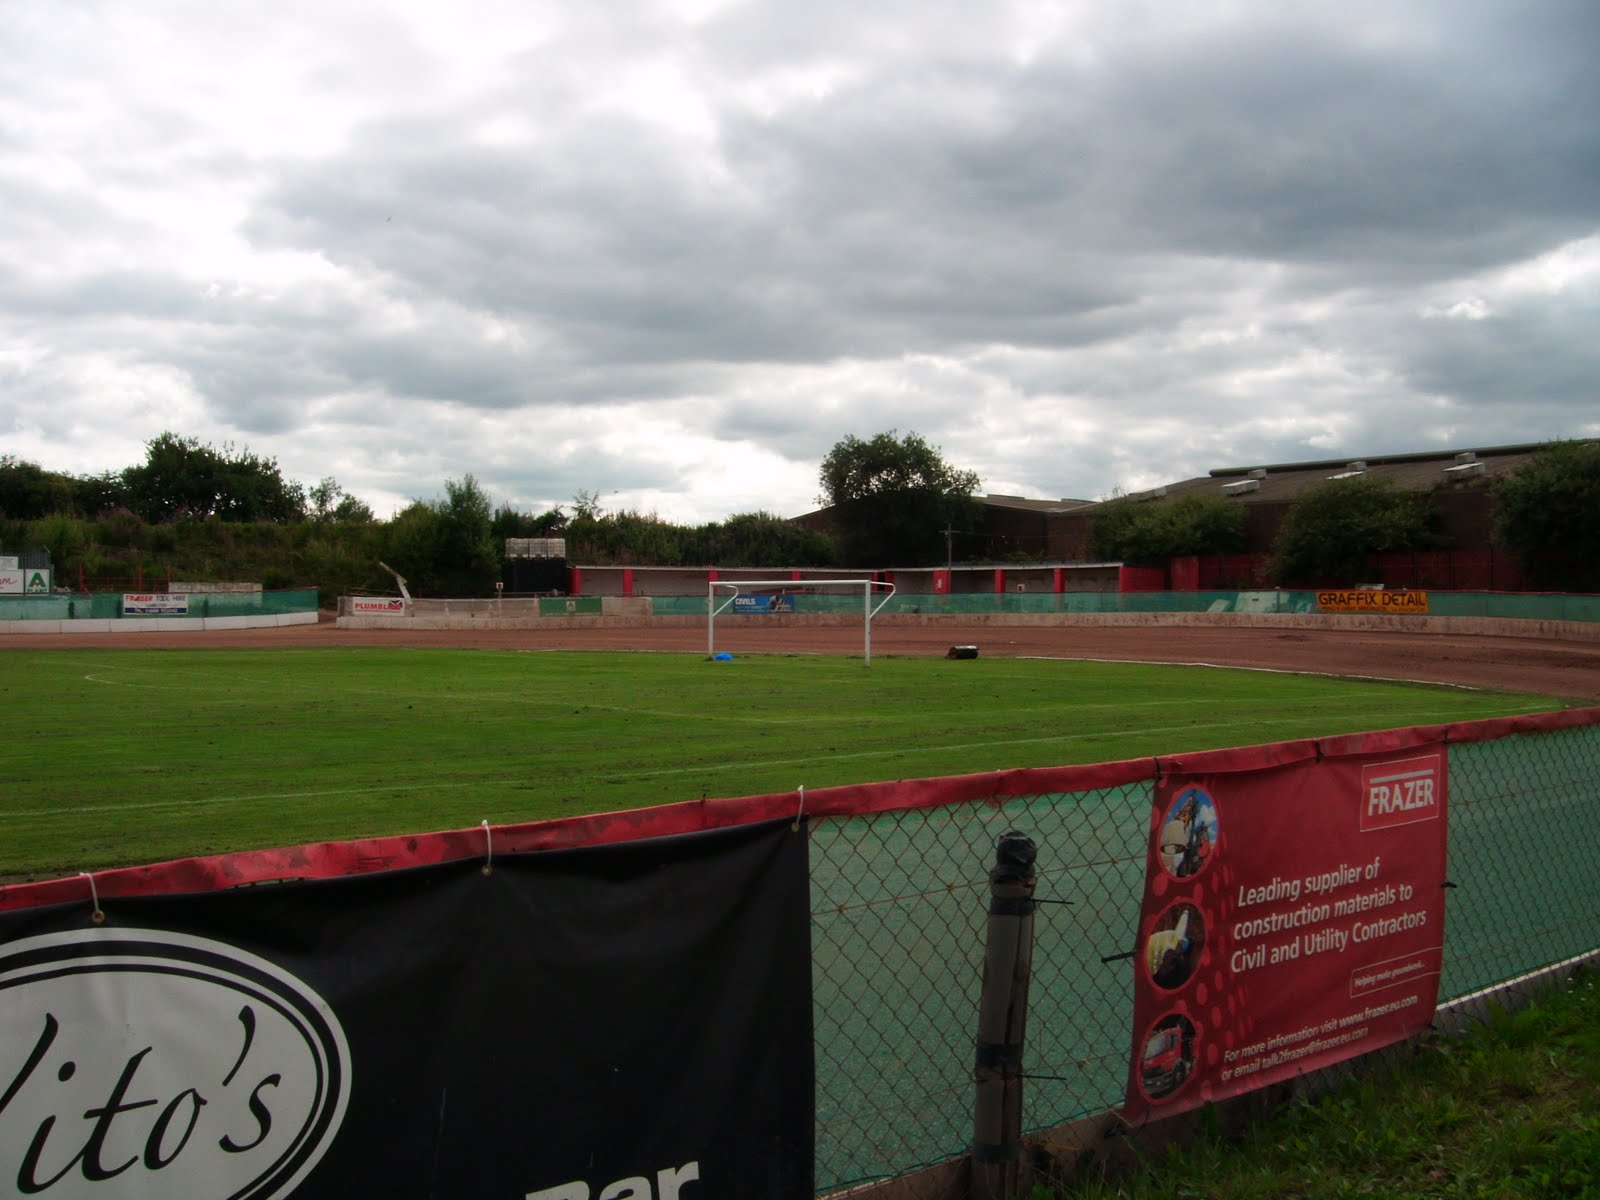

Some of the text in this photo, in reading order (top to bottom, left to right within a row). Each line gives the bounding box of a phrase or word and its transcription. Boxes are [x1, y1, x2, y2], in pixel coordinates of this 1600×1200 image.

[1318, 592, 1427, 606] GRAFFIX DETAIL
[1368, 779, 1435, 817] FRAZER
[1237, 856, 1381, 908] Leading supplier of
[1233, 883, 1413, 941] construction materials to
[1230, 909, 1428, 974] Civil and Utility Contractors
[1224, 994, 1418, 1064] For more information visit www.frazer.eu.com
[1221, 1069, 1232, 1081] or
[1234, 1060, 1260, 1078] email
